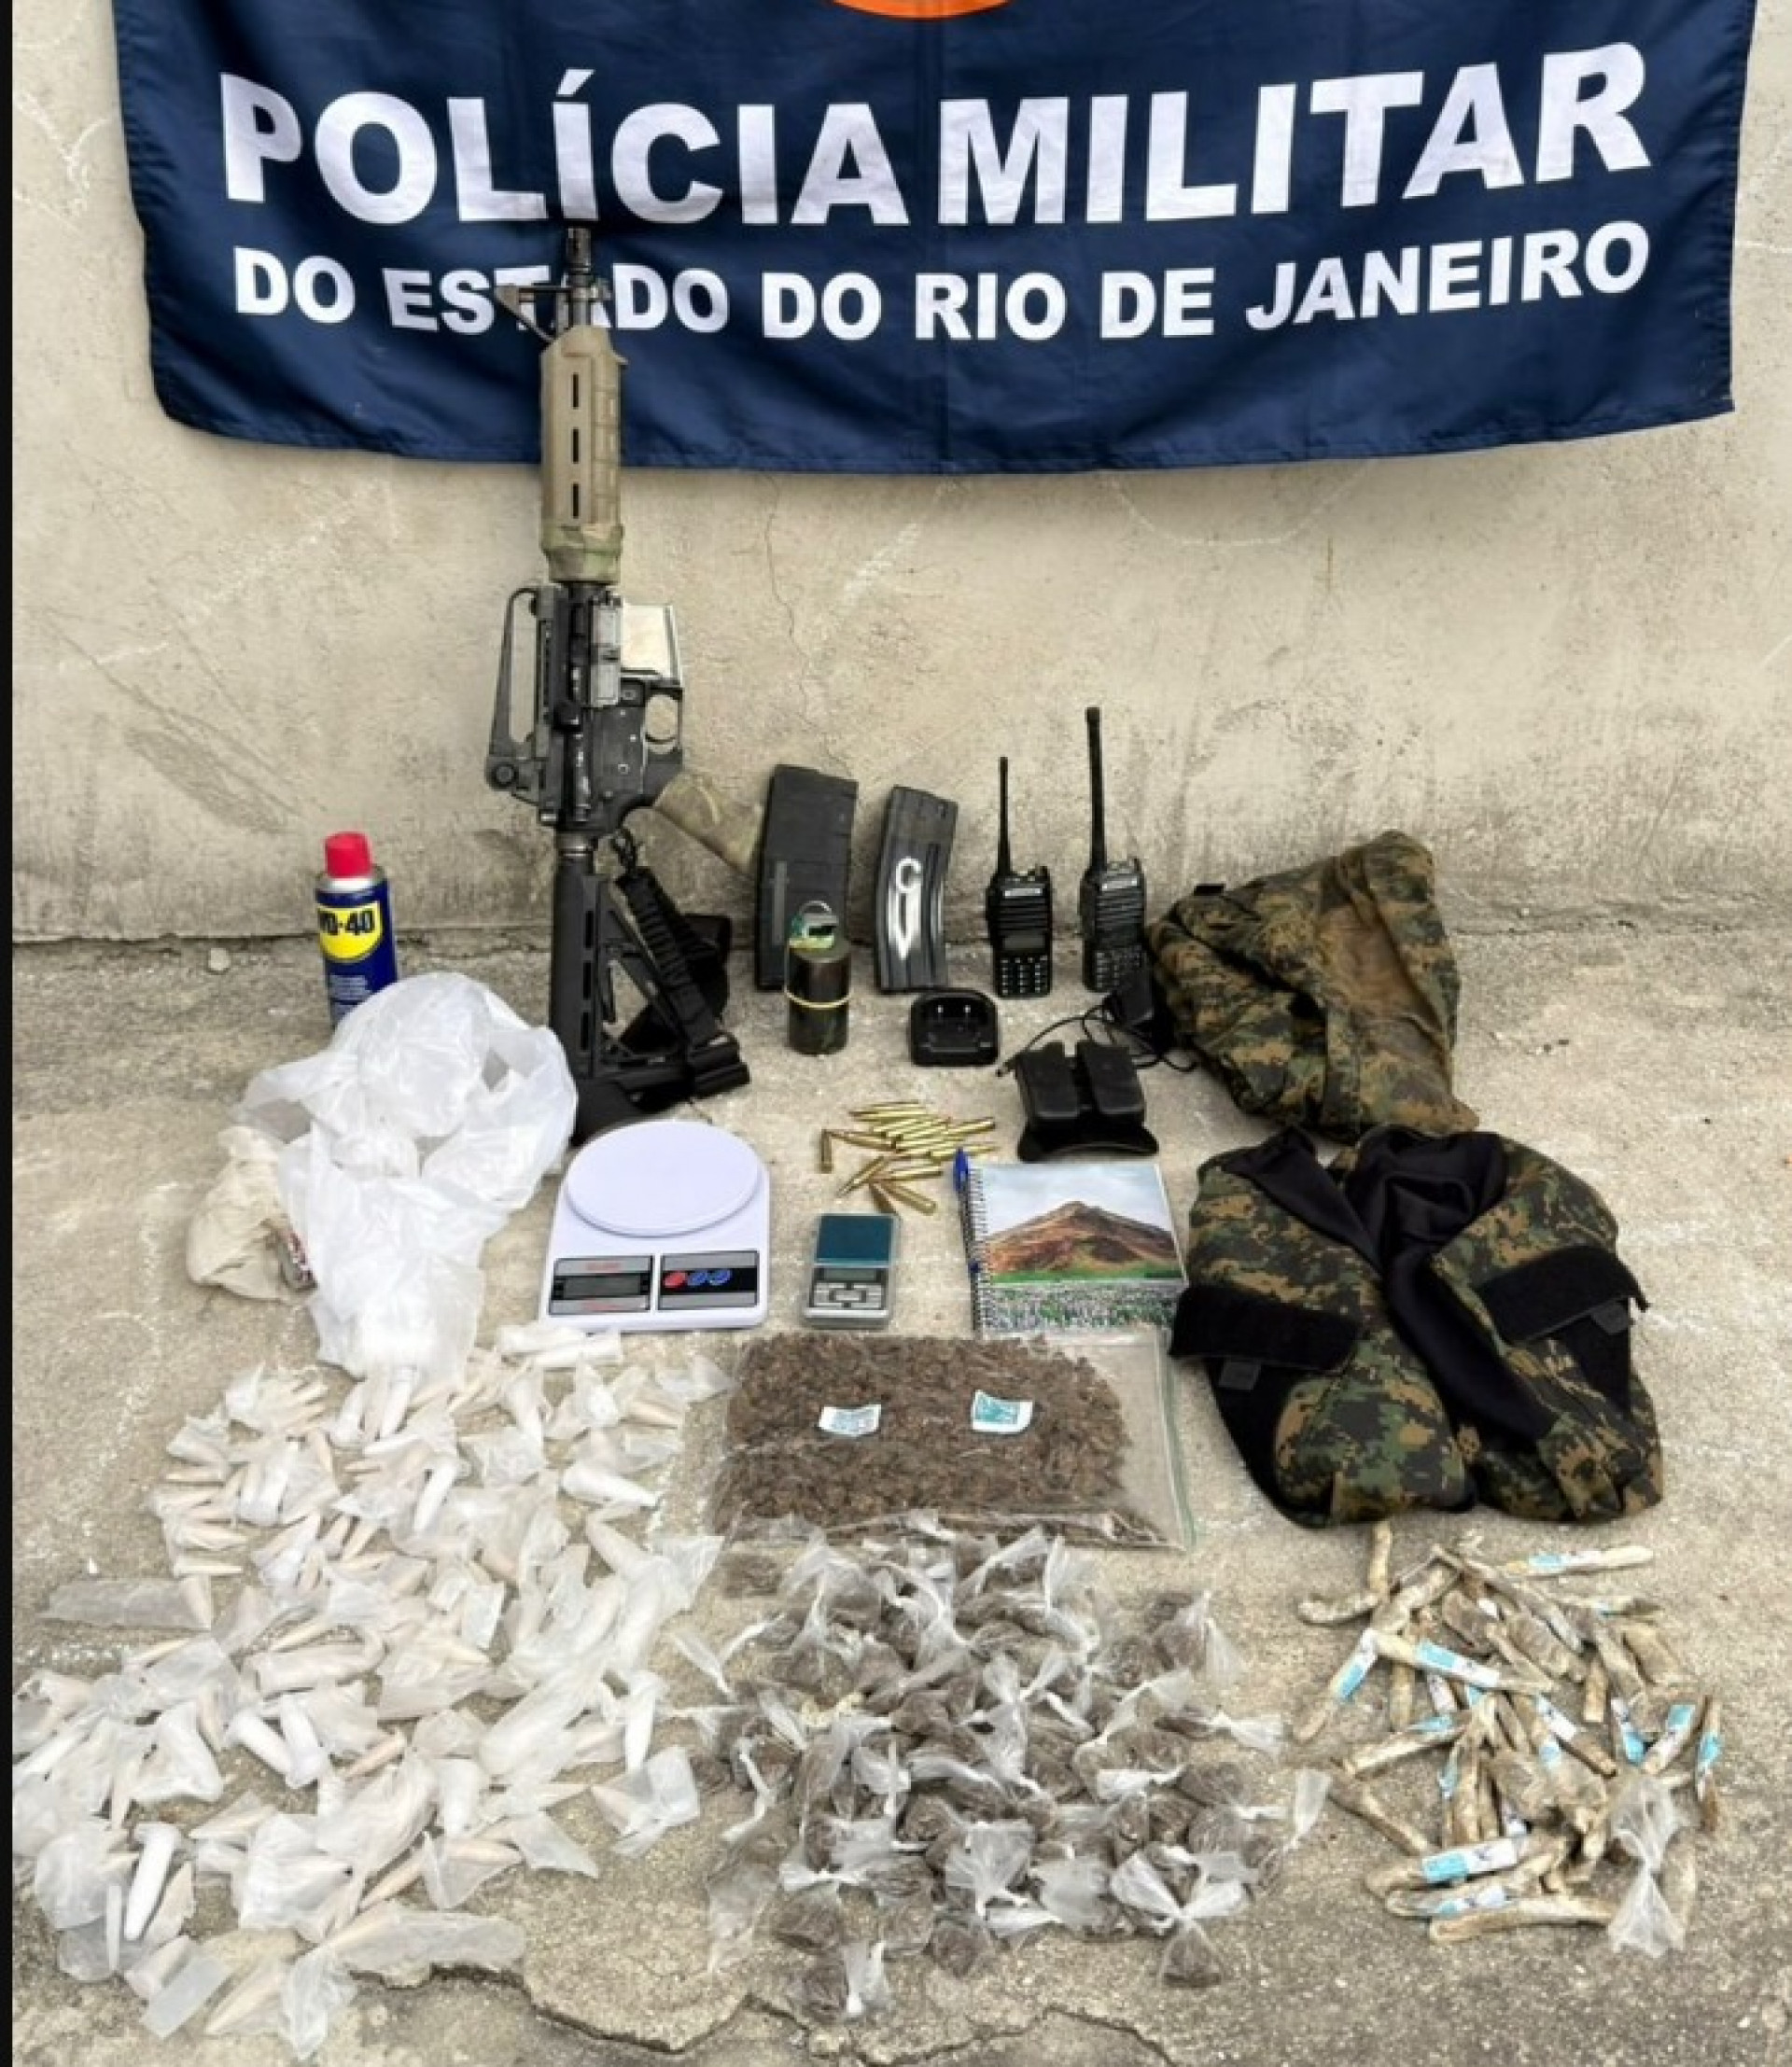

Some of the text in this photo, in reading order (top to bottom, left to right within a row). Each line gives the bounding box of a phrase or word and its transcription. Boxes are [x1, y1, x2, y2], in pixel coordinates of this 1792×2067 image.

[220, 41, 1651, 225] POLÍCIA MILITAR
[232, 245, 356, 325] DO
[762, 272, 883, 341] DO
[915, 272, 1067, 342] RIO
[1100, 267, 1215, 340] DE
[1245, 220, 1650, 331] JANEIRO
